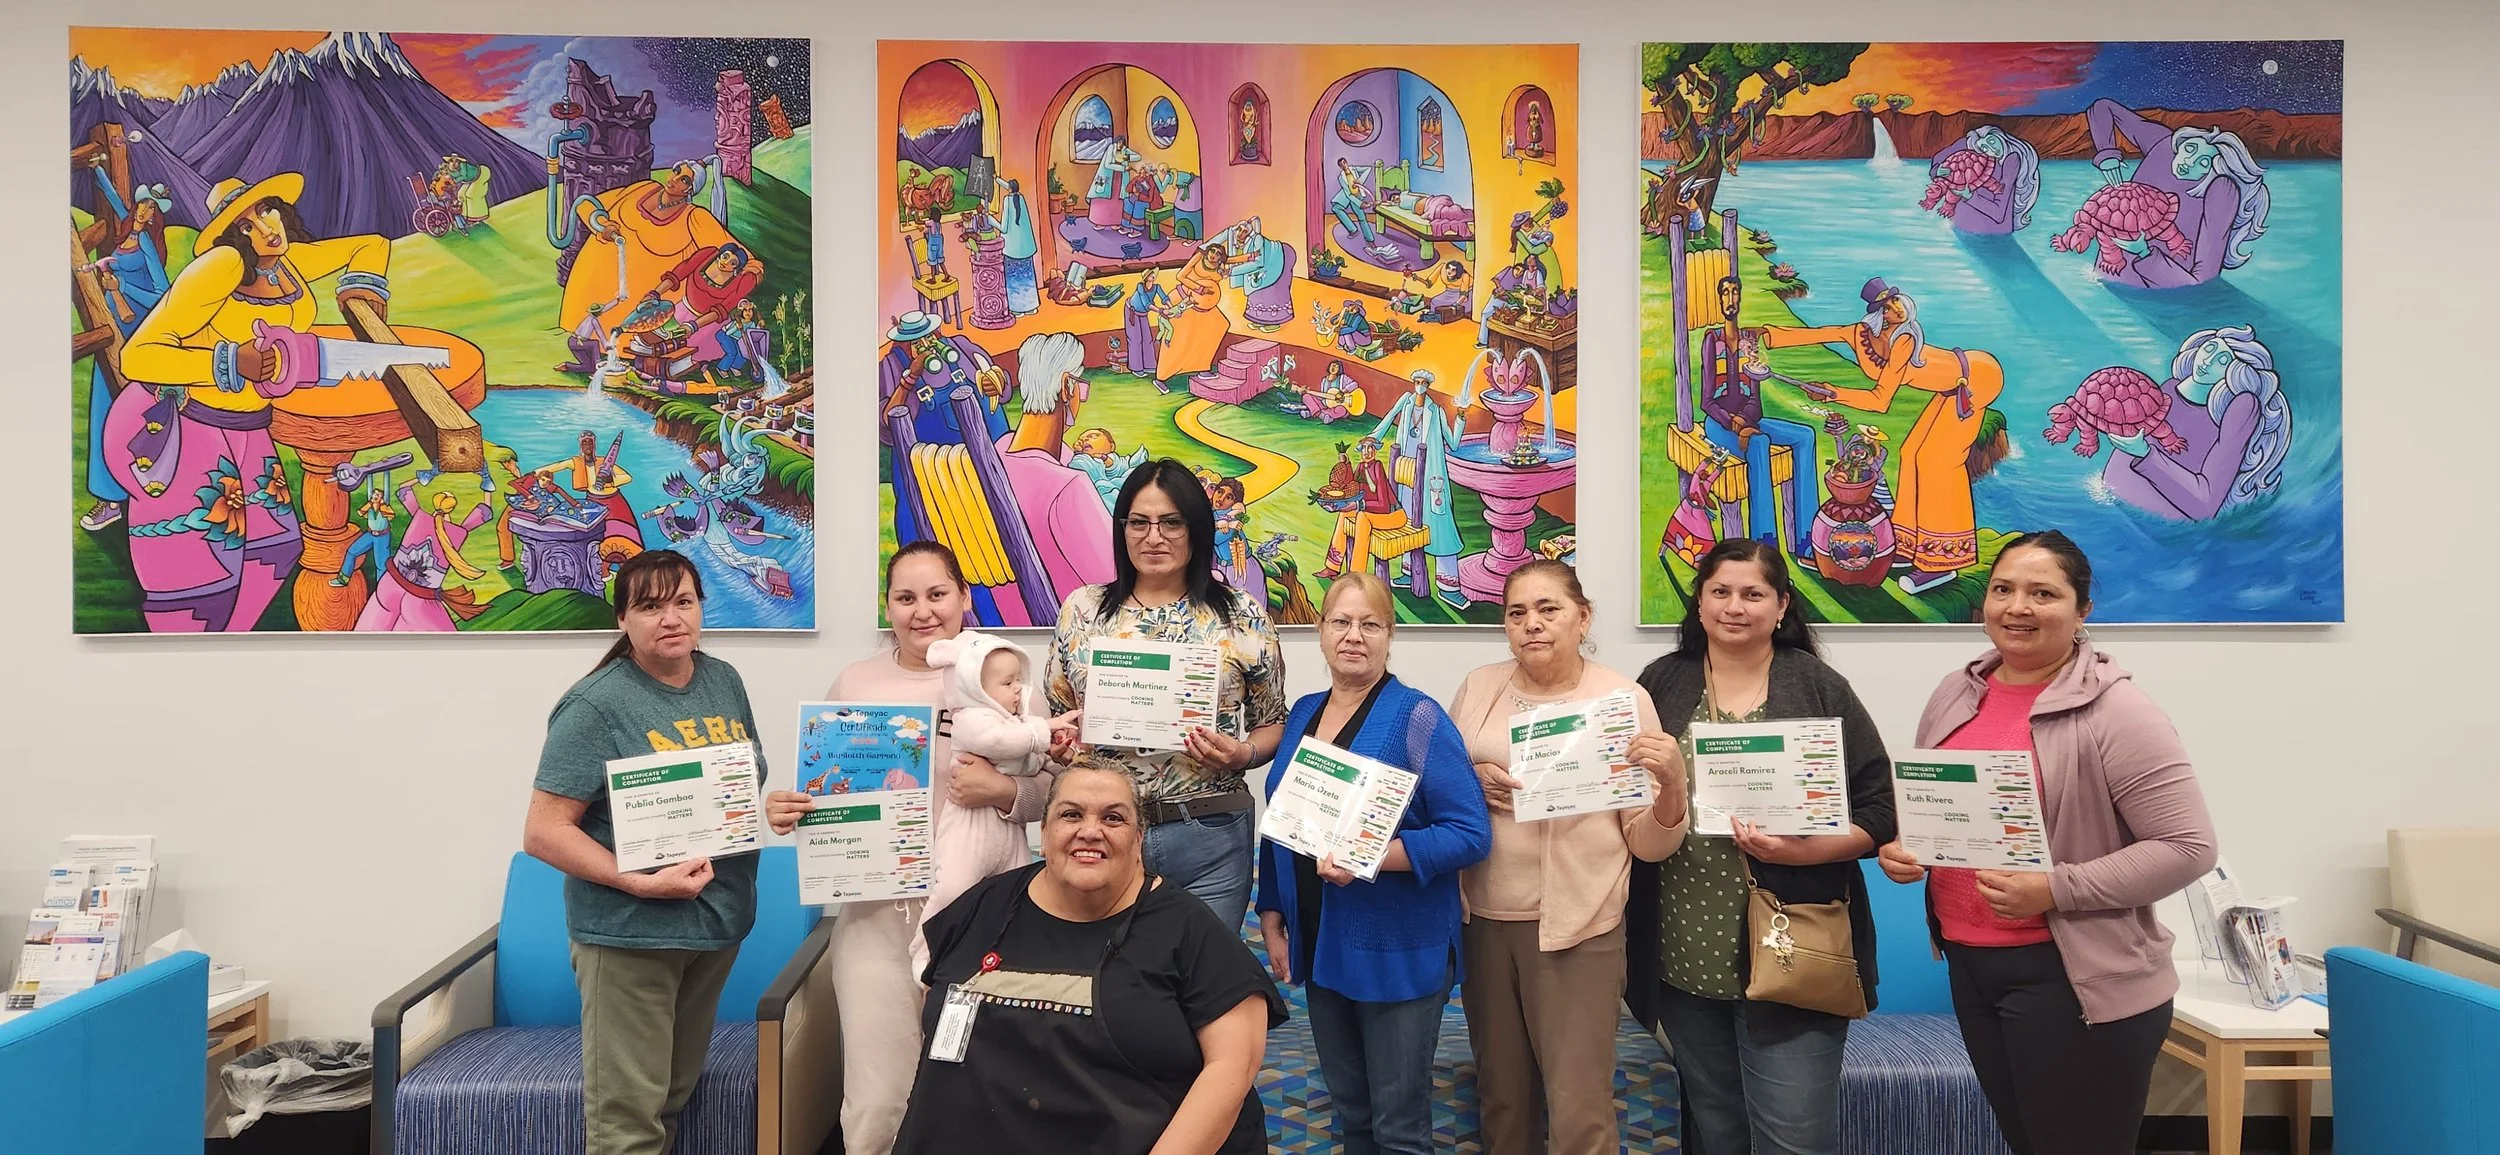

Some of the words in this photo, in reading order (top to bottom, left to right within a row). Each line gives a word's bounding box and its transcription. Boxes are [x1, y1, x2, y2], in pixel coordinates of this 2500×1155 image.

[1098, 679, 1130, 688] Deborah
[1132, 681, 1168, 691] Martinez
[855, 709, 888, 718] Tepeyac
[840, 721, 887, 732] Certificado
[1535, 749, 1561, 759] Macias
[1303, 758, 1336, 774] COMPLETION
[1306, 753, 1336, 769] CERTIFICATE
[621, 770, 660, 781] CERTIFICATE
[1708, 767, 1738, 775] Araceli
[1740, 766, 1776, 775] Ramirez
[622, 776, 661, 786] COMPLETION
[1293, 776, 1316, 790] Maria
[625, 799, 654, 810] Publia
[656, 794, 694, 805] Gamboa
[1906, 793, 1925, 803] Ruth
[1926, 795, 1954, 804] Rivera
[667, 808, 693, 816] COOKING
[667, 812, 693, 820] MATTERS
[806, 810, 841, 818] CERTIFICATE
[809, 838, 829, 846] Aida
[830, 837, 862, 845] Morgan
